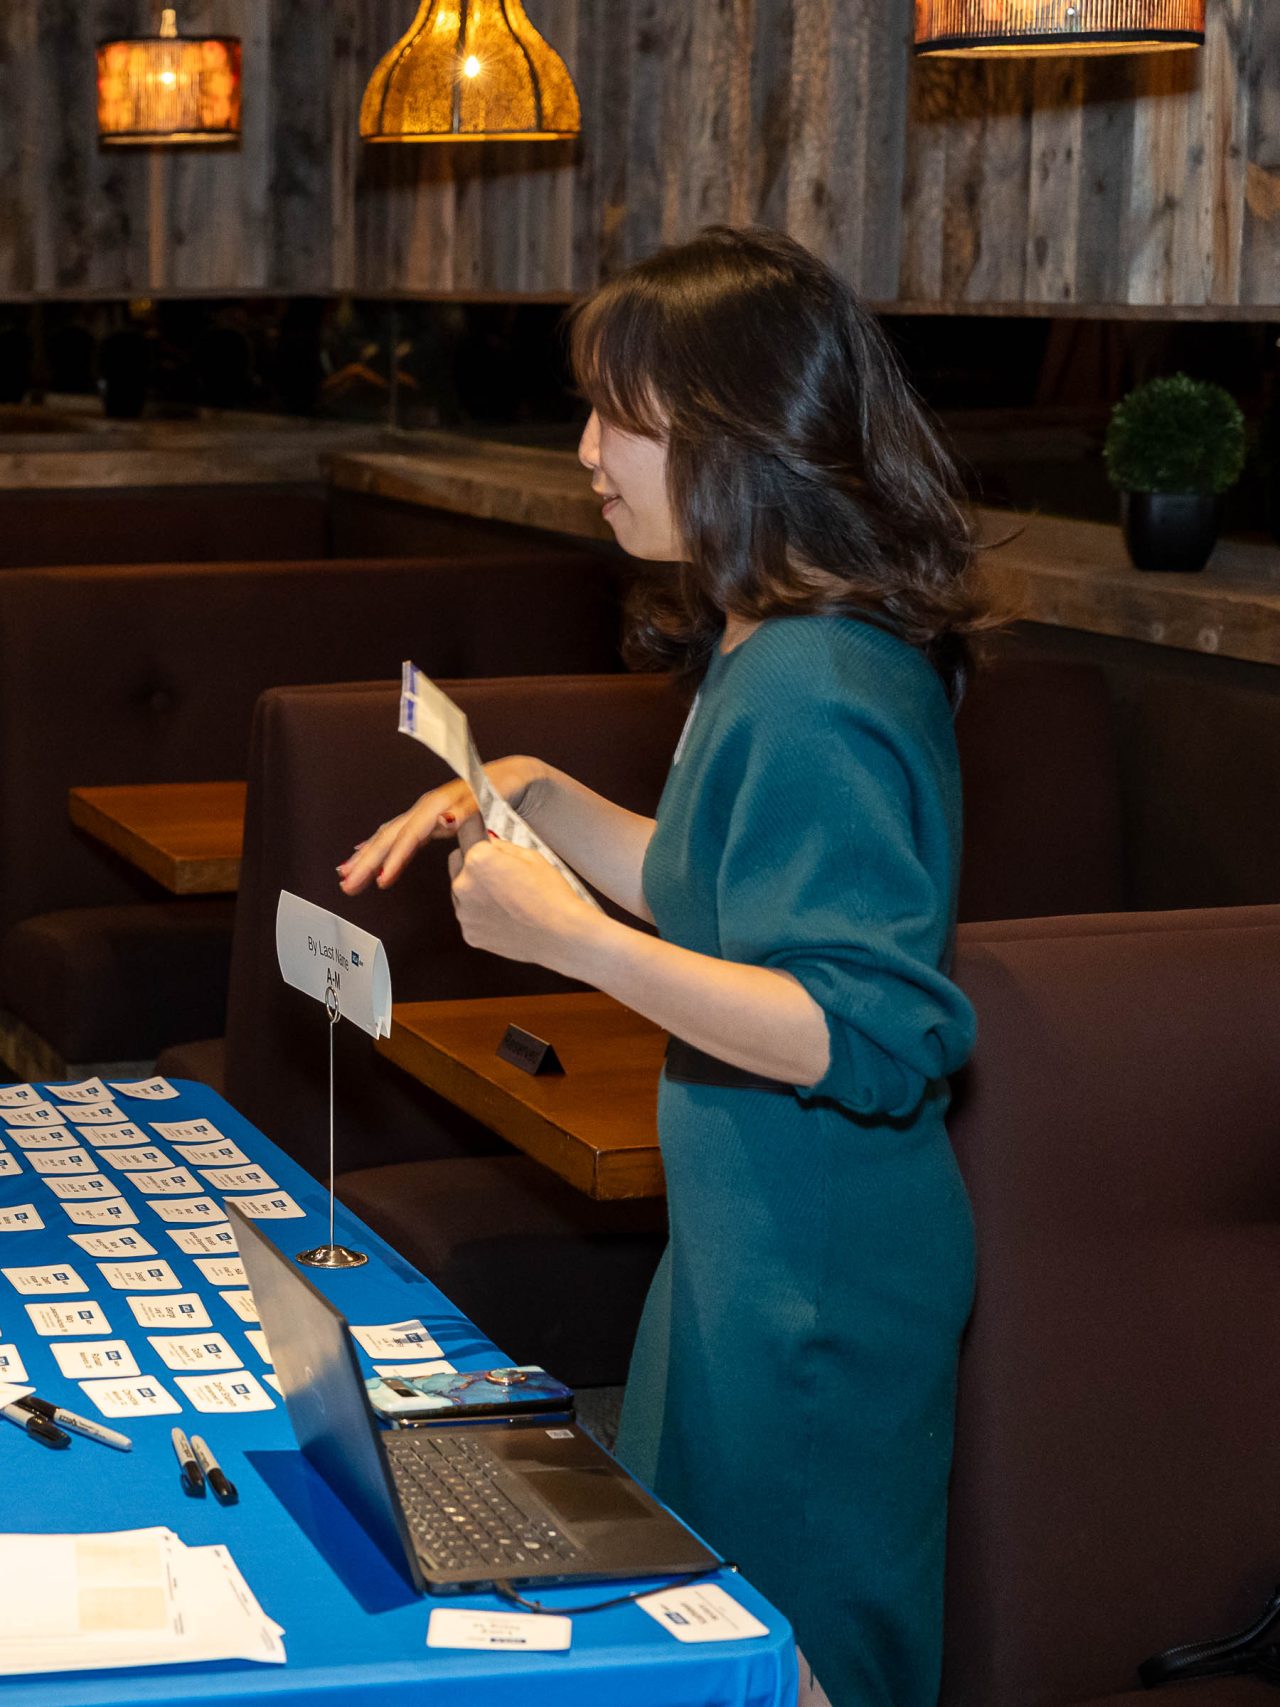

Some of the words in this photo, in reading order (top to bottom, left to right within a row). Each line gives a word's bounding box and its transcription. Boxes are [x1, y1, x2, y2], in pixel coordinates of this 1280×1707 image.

[307, 935, 318, 957] By
[318, 940, 334, 961] Last
[335, 947, 349, 972] Name
[326, 967, 341, 991] A-M
